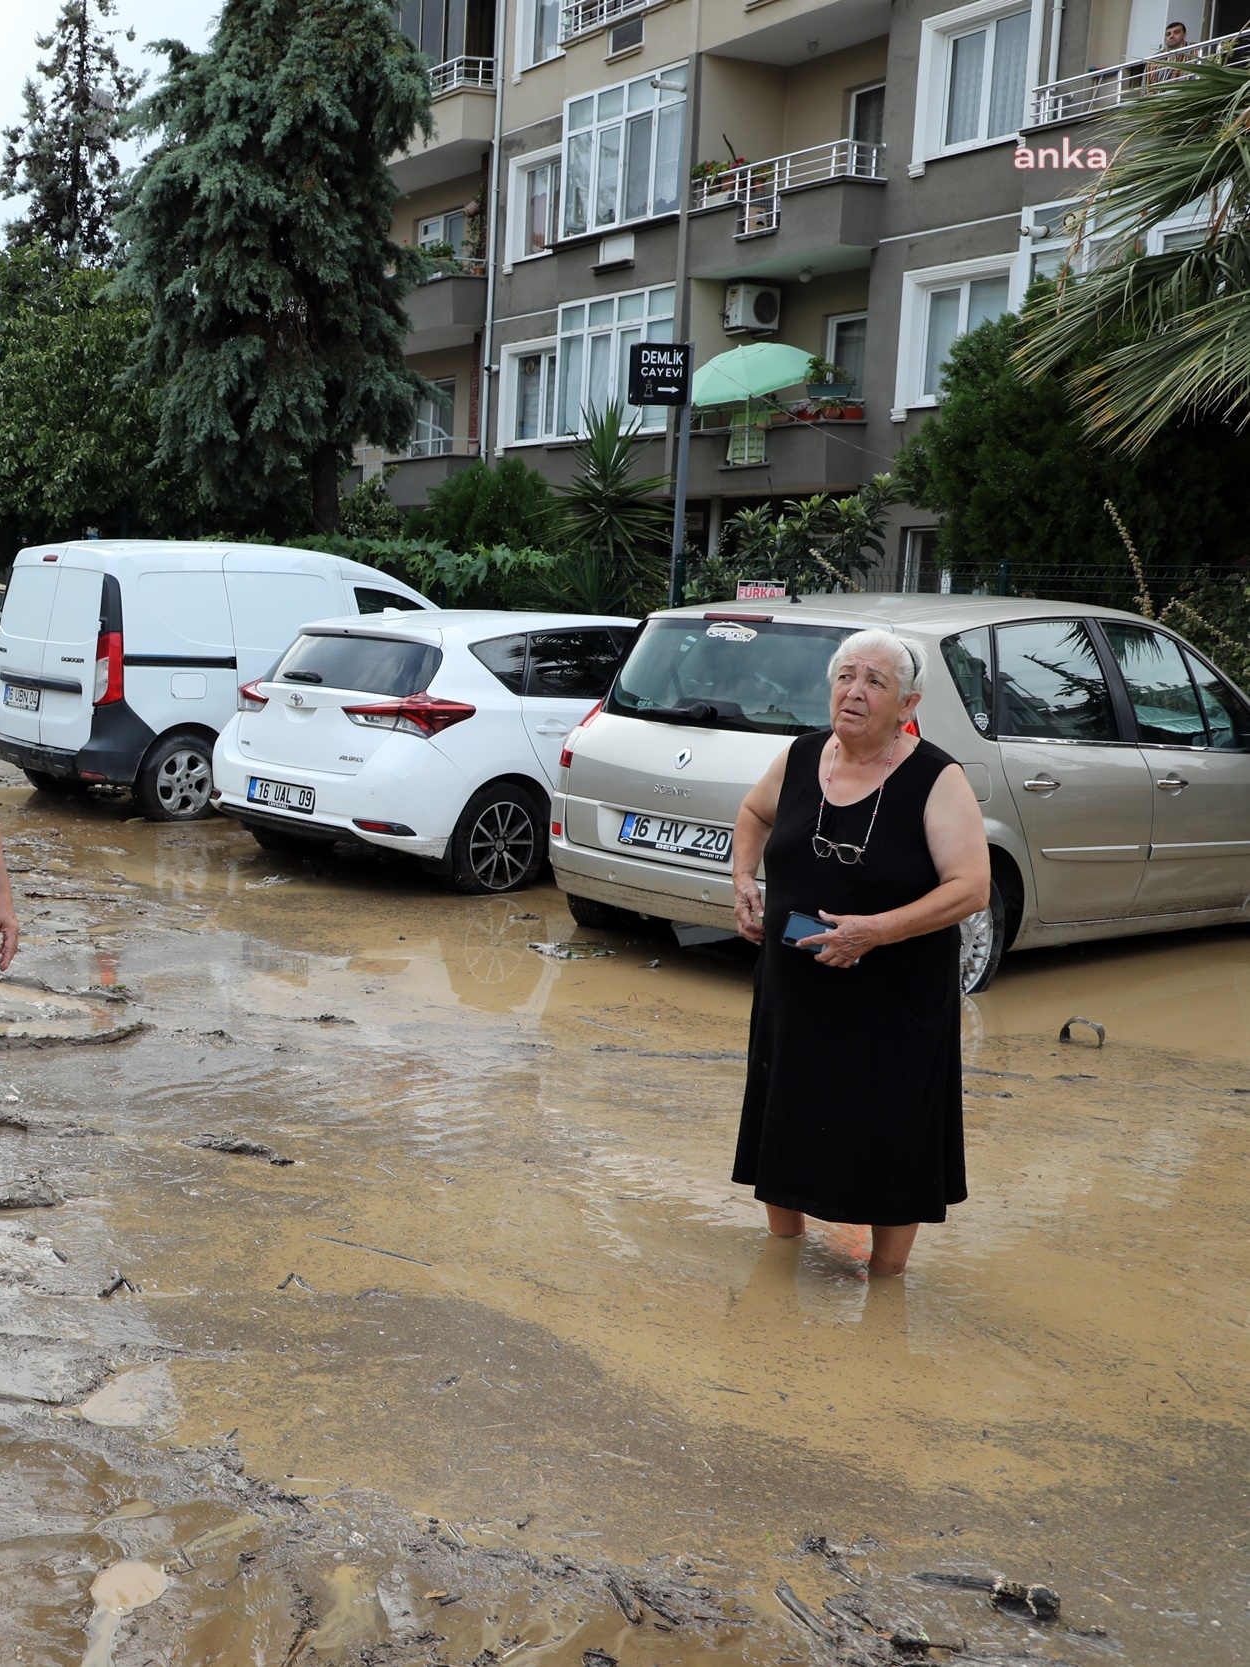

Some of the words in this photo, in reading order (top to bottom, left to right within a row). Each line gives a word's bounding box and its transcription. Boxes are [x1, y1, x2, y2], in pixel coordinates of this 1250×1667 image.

[641, 349, 684, 365] DEMLİK
[737, 587, 784, 599] FURKAN
[61, 656, 85, 664] DOKKER
[15, 689, 28, 704] UBN
[30, 691, 38, 706] 04
[339, 754, 365, 763] AURIS
[258, 782, 270, 799] 16
[274, 784, 291, 804] UAL
[298, 789, 313, 807] 09
[653, 783, 691, 798] SCENIC
[632, 816, 651, 838] 16
[656, 820, 688, 844] HV
[690, 827, 729, 852] 220
[655, 842, 685, 853] BEST
